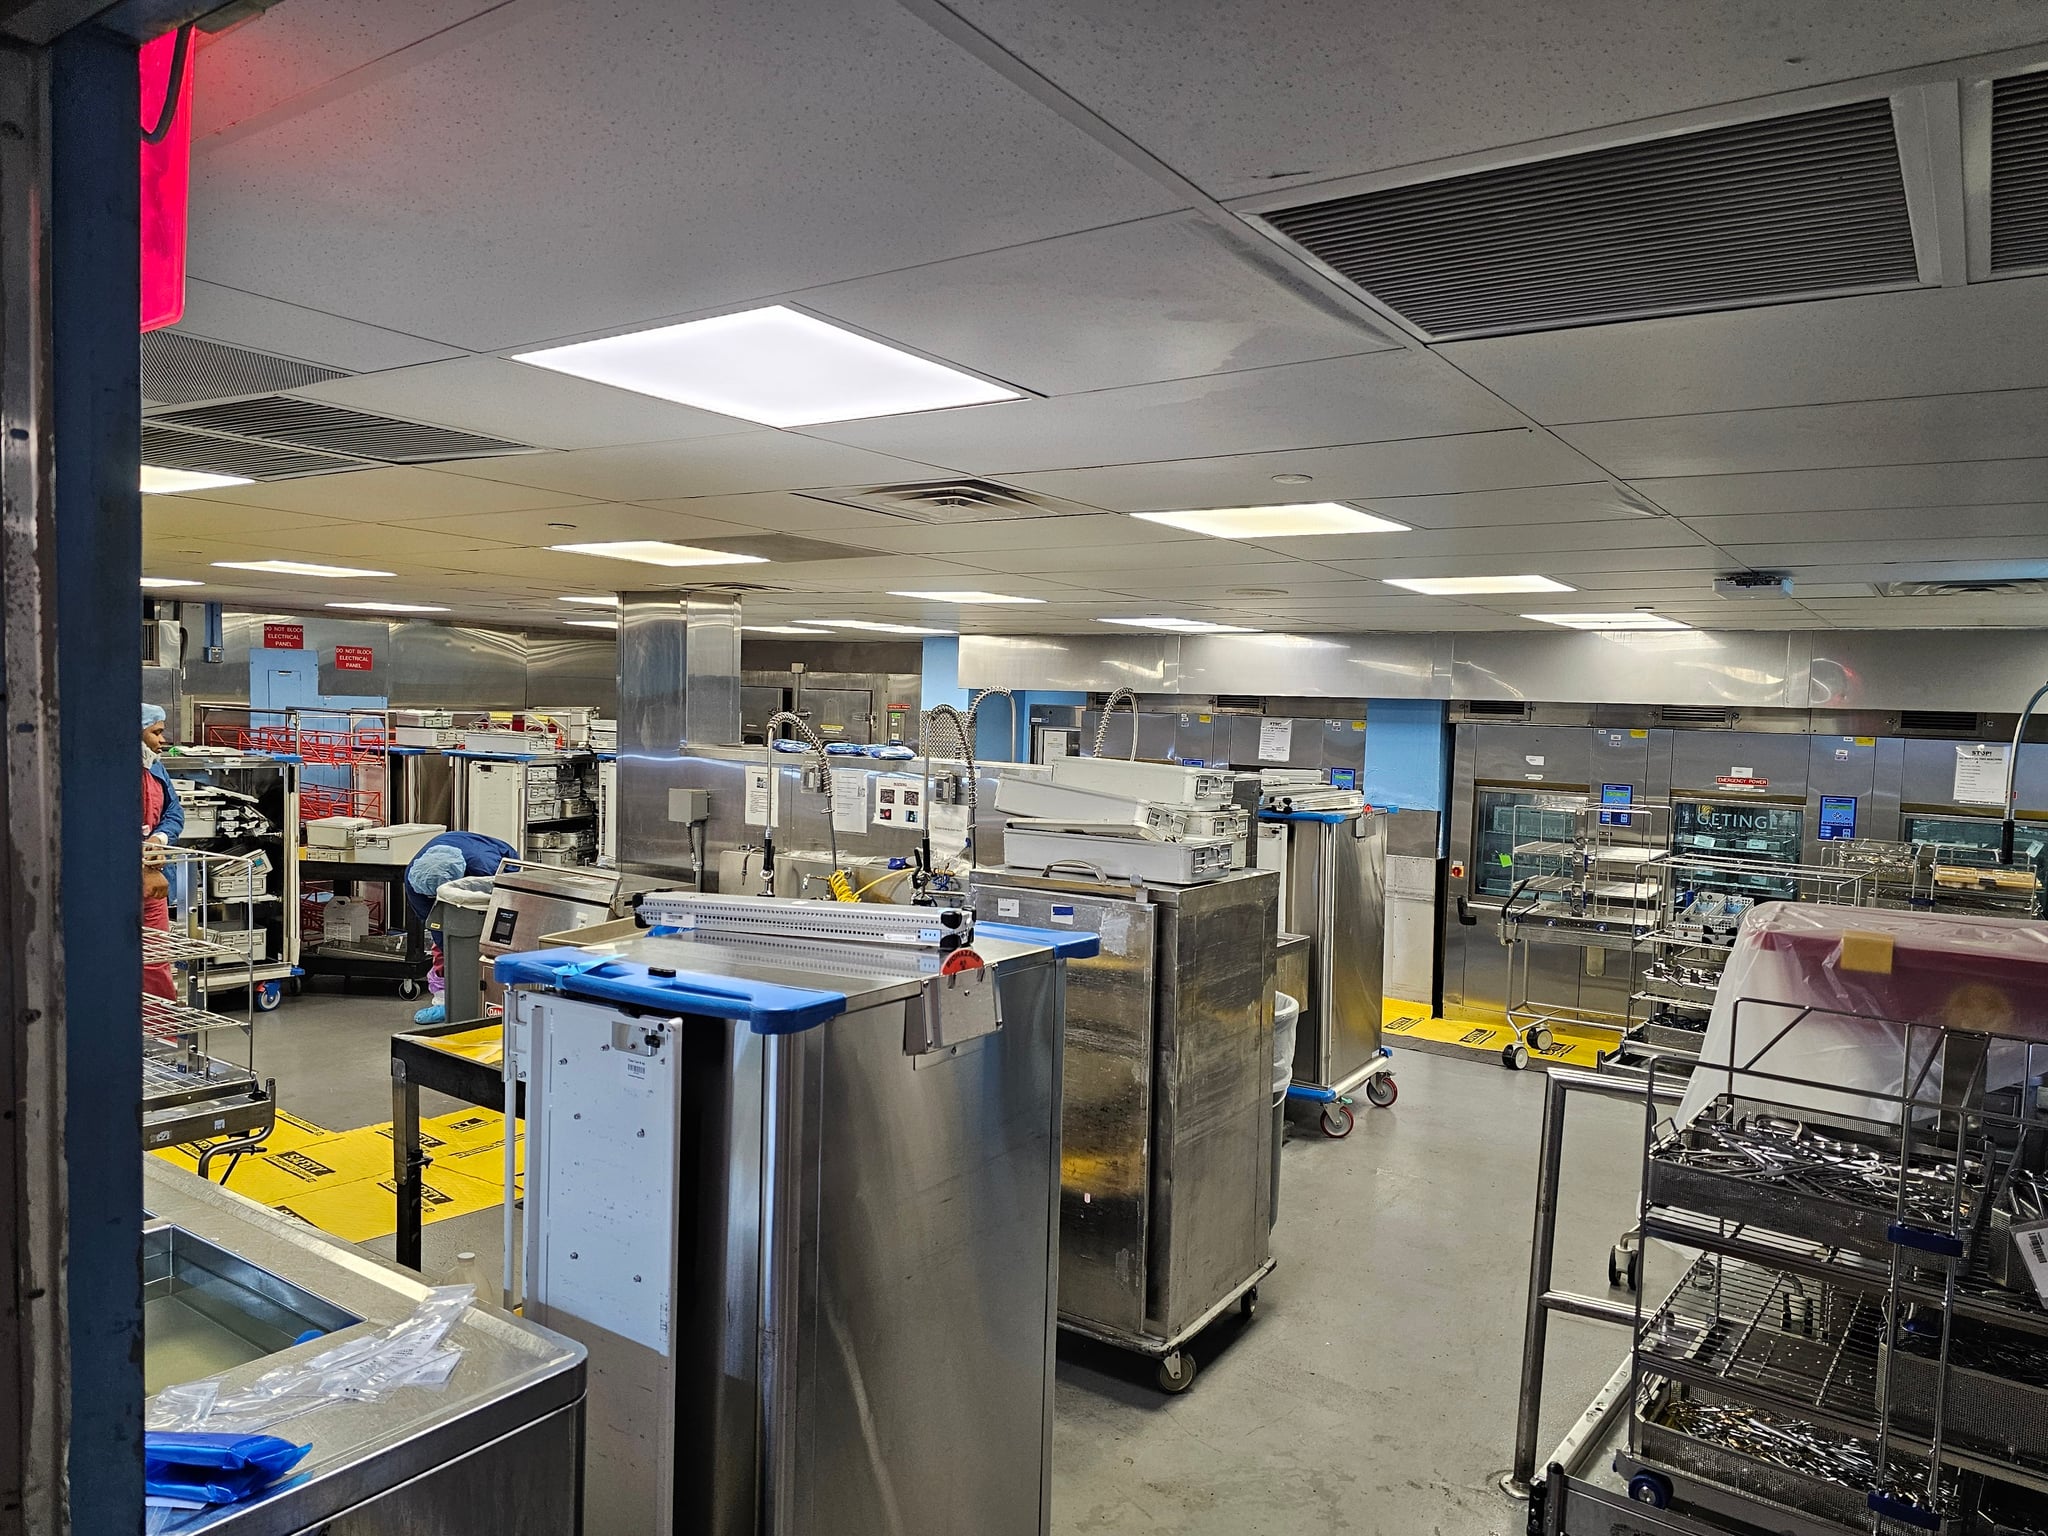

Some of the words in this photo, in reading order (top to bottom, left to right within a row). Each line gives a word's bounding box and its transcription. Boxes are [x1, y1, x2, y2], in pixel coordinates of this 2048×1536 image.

[1717, 777, 1747, 785] EMERGENCY
[489, 1008, 503, 1016] DAN
[283, 1152, 328, 1173] SAFETY
